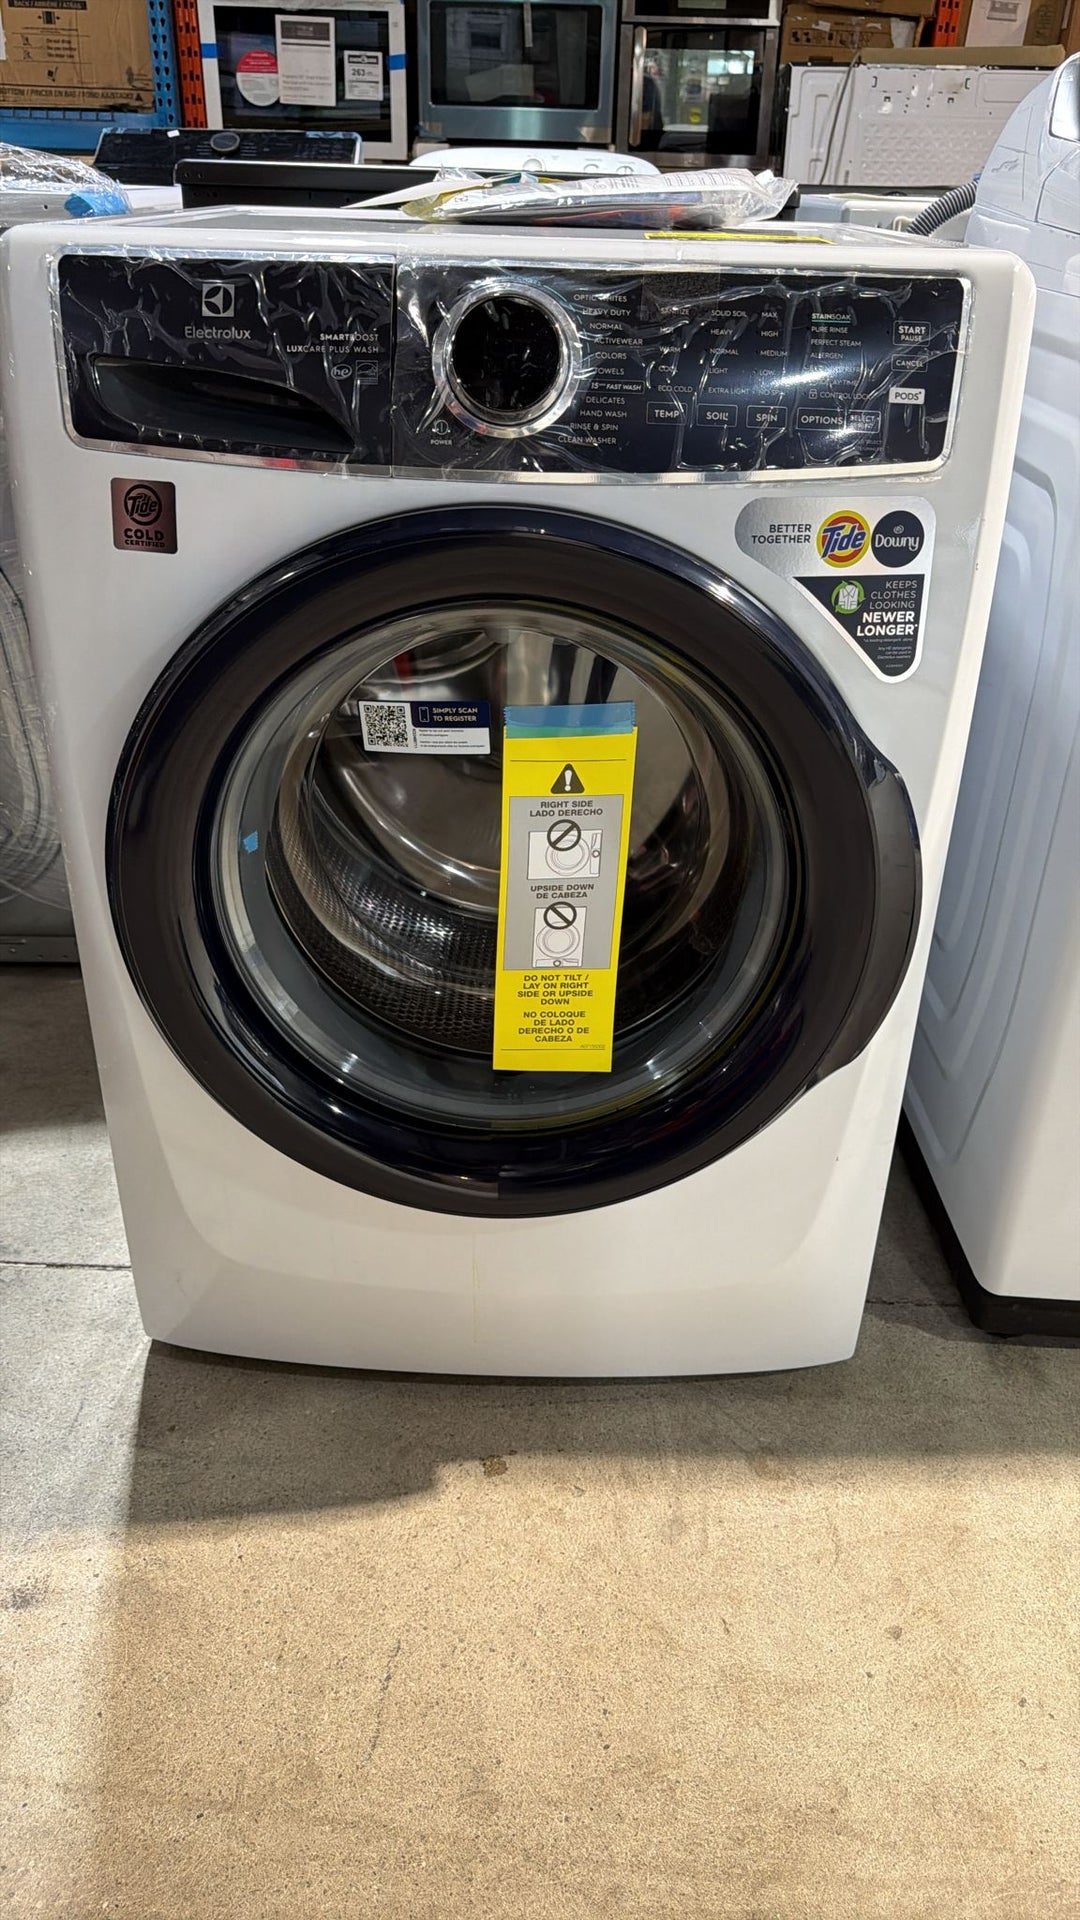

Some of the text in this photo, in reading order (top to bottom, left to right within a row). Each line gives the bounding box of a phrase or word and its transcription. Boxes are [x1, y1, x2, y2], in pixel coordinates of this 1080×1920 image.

[573, 294, 627, 303] OPTIC HITES
[582, 308, 631, 317] HEAVY DUTY
[732, 310, 747, 318] SOIL
[761, 311, 778, 319] MAX
[590, 323, 622, 331] NORMAL
[829, 326, 848, 334] RINSE
[898, 325, 926, 335] START
[184, 326, 251, 340] Electrolux
[593, 338, 643, 346] ACTIVEWEAR
[839, 339, 862, 347] STEAM
[900, 334, 923, 343] PAUSE
[286, 345, 326, 353] LUXCARE
[353, 346, 379, 354] WASH
[710, 348, 738, 356] NORMAL
[595, 352, 627, 360] COLORS
[895, 359, 924, 367] CANCEL
[594, 367, 625, 375] TOWELS
[674, 385, 693, 393] COLD
[730, 387, 750, 395] LIGHT
[820, 391, 852, 399] CONTROL
[586, 397, 626, 405] DELICATES
[580, 409, 627, 418] HAND WASH
[654, 410, 680, 418] TEMP
[705, 411, 728, 421] SOIL
[755, 412, 778, 422] SPIN
[800, 415, 843, 424] OPTIONS
[601, 423, 619, 431] SPIN
[557, 435, 617, 444] CLEAN WASHER
[128, 492, 158, 518] Tide
[769, 523, 812, 534] BETTER
[124, 528, 164, 541] COLD
[125, 539, 166, 548] CERTIFIED
[751, 534, 811, 545] TOGETHER
[820, 522, 867, 560] Tide
[874, 534, 920, 551] Downy
[885, 580, 918, 589] KEEPS
[870, 590, 917, 600] CLOTHES
[869, 600, 916, 610] LOOKING
[862, 611, 915, 624] NEWER
[541, 800, 593, 809] RIGHT SIDE
[529, 808, 603, 817] LADO DERECHO
[530, 883, 595, 892] UPSIDE DOWN
[551, 891, 588, 899] CABEZA
[523, 974, 538, 982] DO
[540, 974, 560, 982] NOT
[523, 982, 540, 990] LAY
[560, 981, 589, 989] RIGHT
[517, 990, 539, 998] SIDE
[558, 990, 593, 998] UPSIDE
[539, 1010, 586, 1018] COLOQUE
[518, 1027, 564, 1035] DERECHO
[576, 1026, 590, 1034] DE
